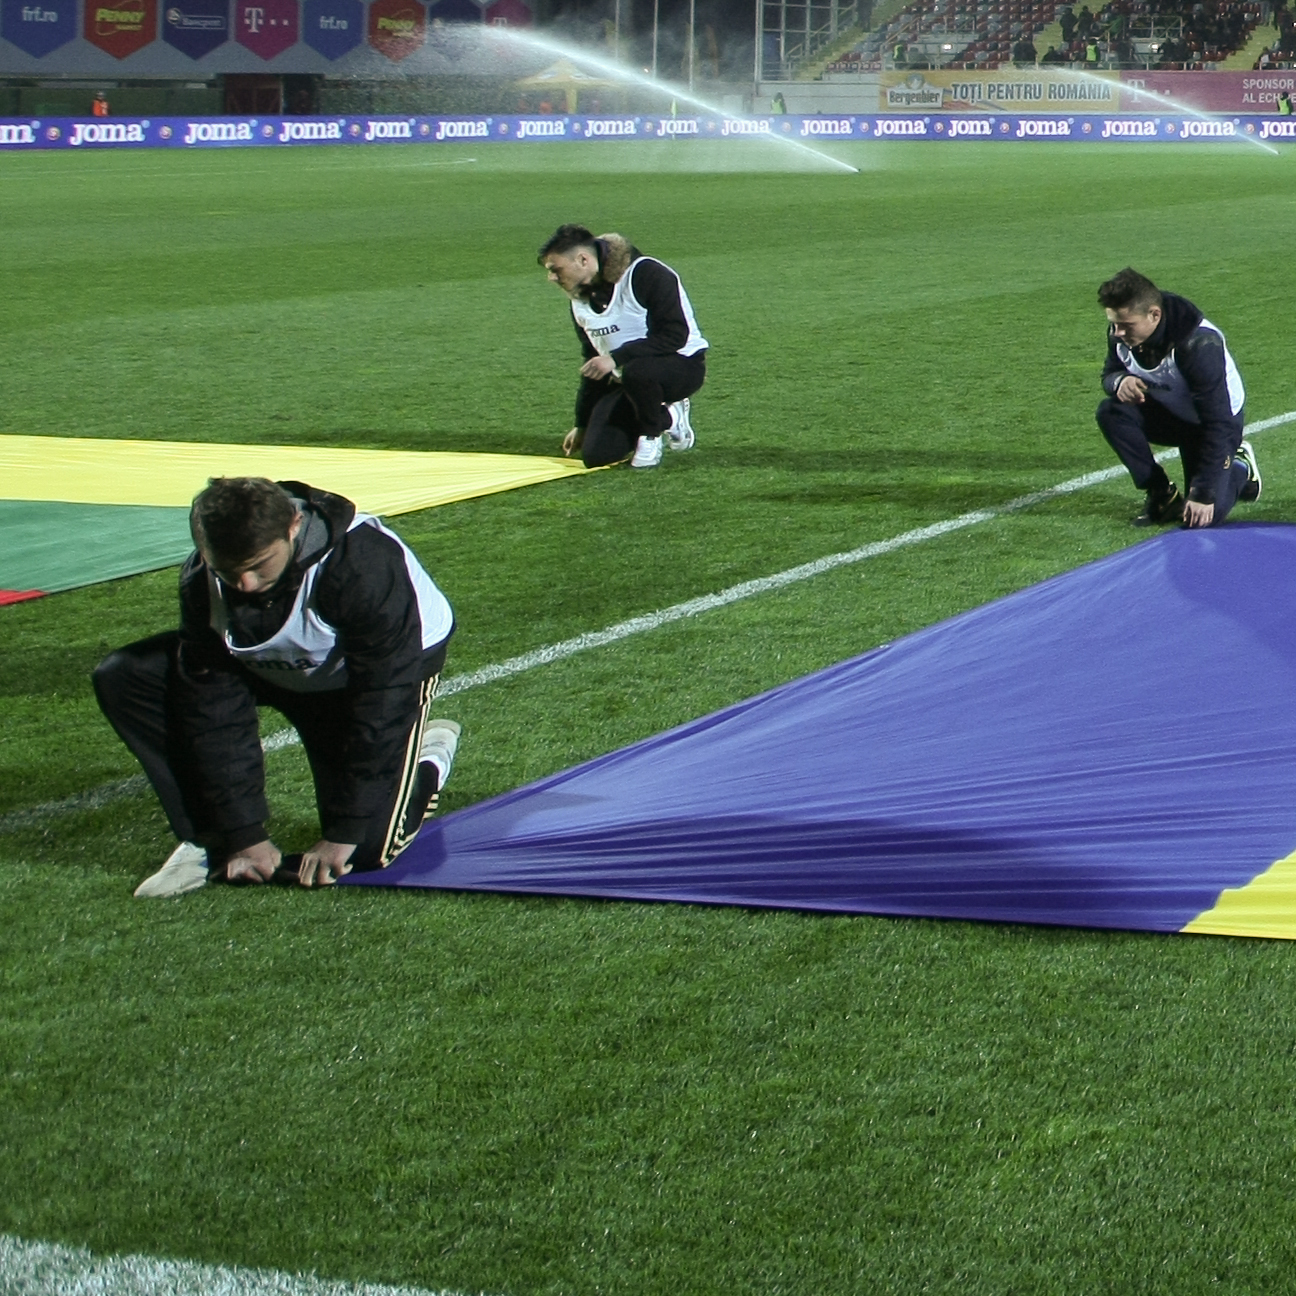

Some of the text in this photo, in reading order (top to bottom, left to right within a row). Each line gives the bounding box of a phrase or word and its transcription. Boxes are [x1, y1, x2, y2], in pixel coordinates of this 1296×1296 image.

[21, 6, 58, 23] frf.ro
[1242, 78, 1293, 90] SPONSOR
[987, 83, 1042, 100] PENTRU
[1242, 92, 1257, 103] AL
